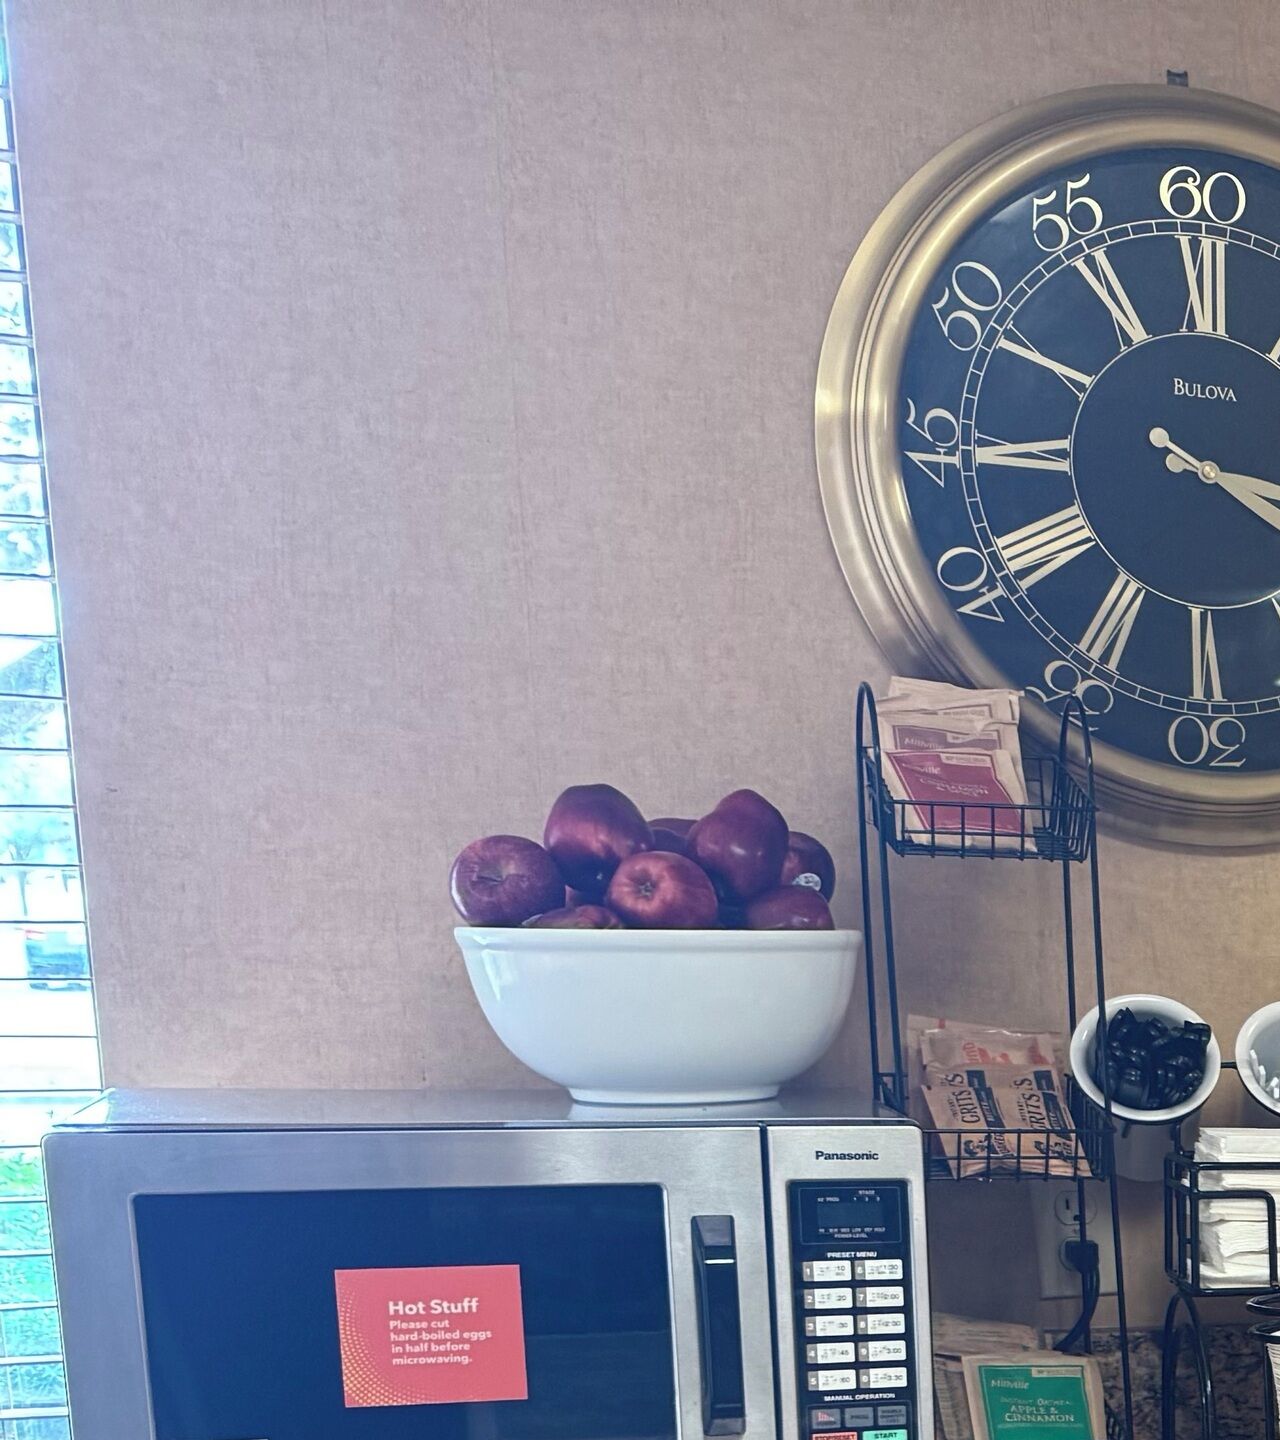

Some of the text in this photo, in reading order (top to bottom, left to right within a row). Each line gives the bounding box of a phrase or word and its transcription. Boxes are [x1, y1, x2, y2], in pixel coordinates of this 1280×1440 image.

[1031, 173, 1103, 253] 55
[1159, 165, 1246, 226] 60
[935, 261, 1003, 352] 50
[1074, 248, 1152, 352] XI
[1174, 235, 1229, 336] XII
[996, 320, 1095, 401] X
[904, 398, 960, 488] 45
[974, 429, 1071, 476] IX
[936, 546, 1006, 623] 40
[1187, 606, 1228, 701] VI
[1168, 714, 1246, 768] 30
[953, 1089, 982, 1124] GRITS
[815, 1150, 880, 1161] Panasonic
[388, 1297, 480, 1316] Hot Stuff
[389, 1319, 450, 1330] Please cut
[390, 1330, 493, 1342] hard-boiled eggs
[391, 1341, 471, 1354] in half before
[392, 1354, 473, 1366] microwaving.
[1004, 1412, 1075, 1423] CINNAMON
[1010, 1404, 1047, 1415] APPLE
[874, 1432, 898, 1440] START
